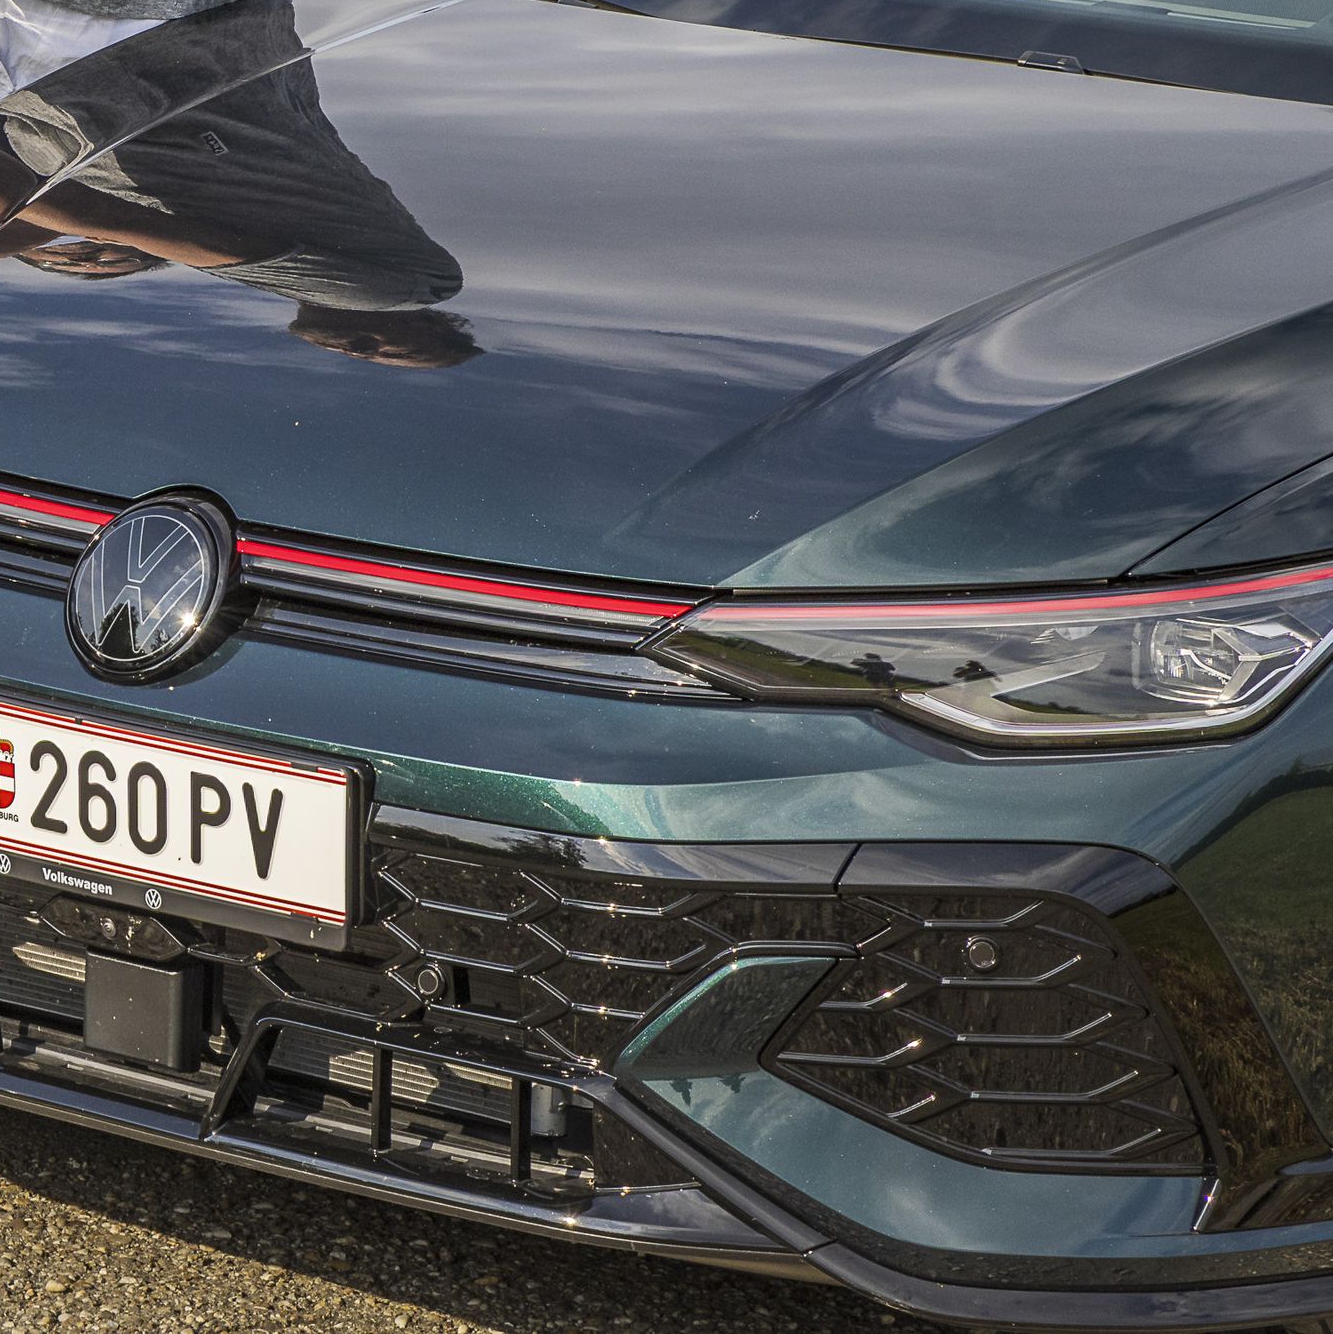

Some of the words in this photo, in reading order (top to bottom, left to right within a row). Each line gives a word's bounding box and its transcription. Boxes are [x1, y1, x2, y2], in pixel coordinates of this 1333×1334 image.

[29, 739, 167, 855] 260
[190, 771, 284, 880] PV
[42, 867, 114, 896] Volkswagen
